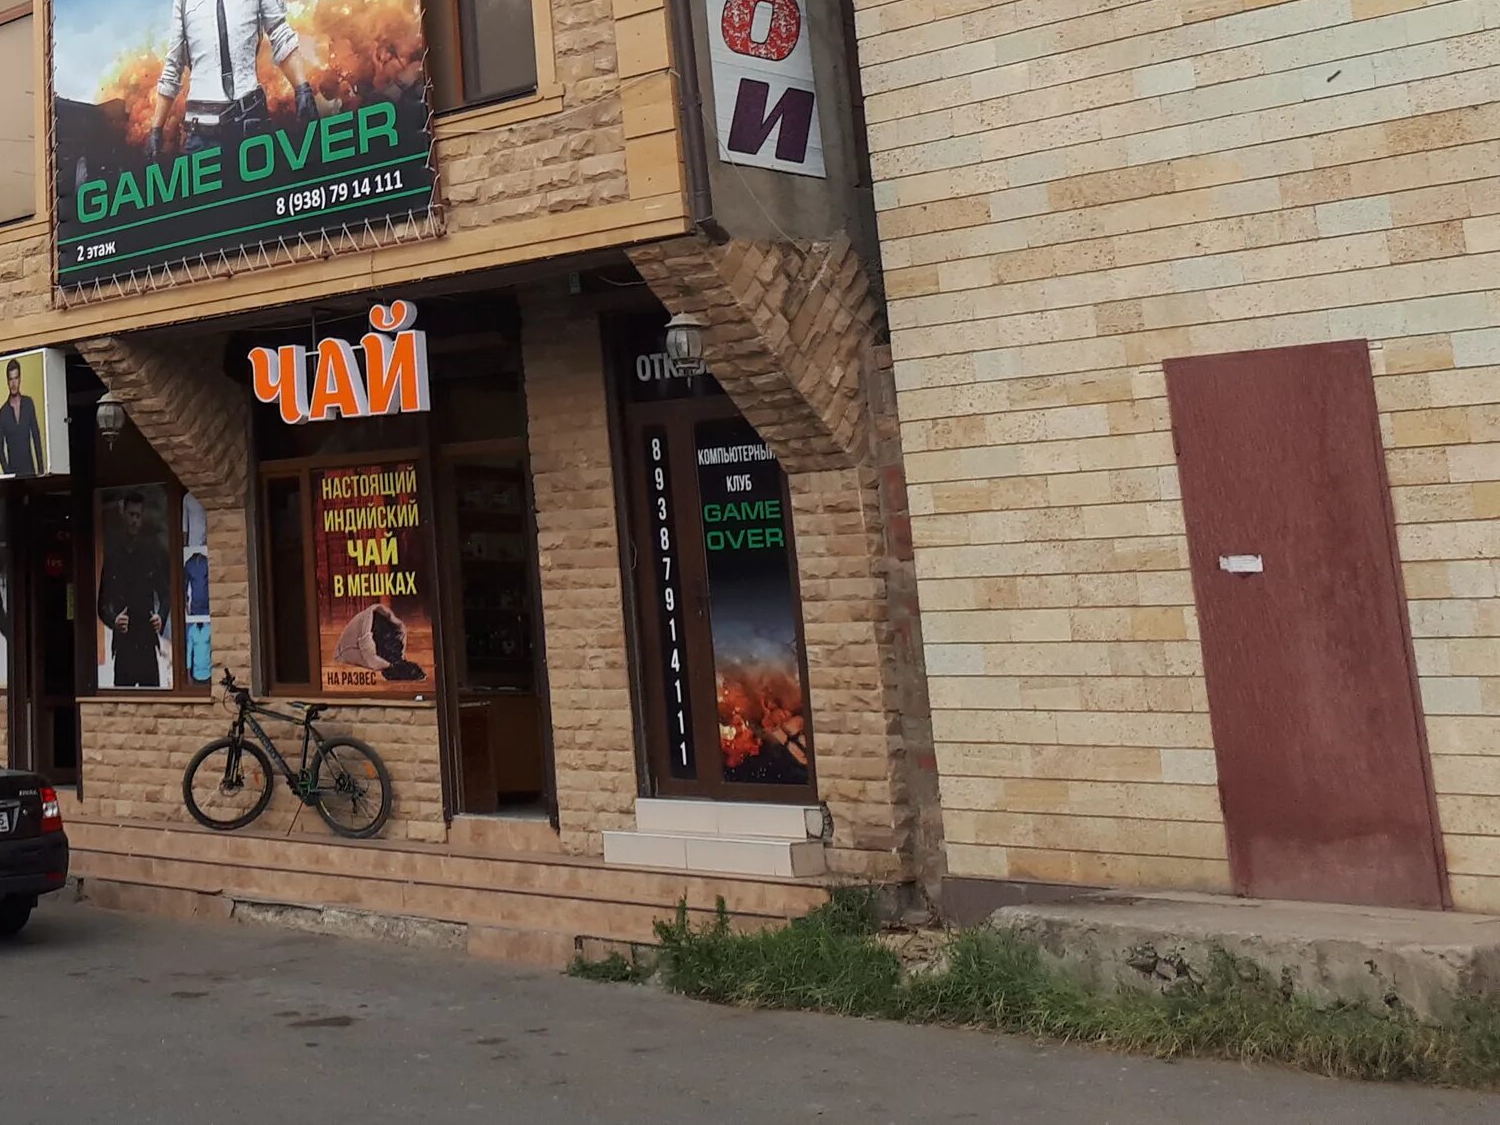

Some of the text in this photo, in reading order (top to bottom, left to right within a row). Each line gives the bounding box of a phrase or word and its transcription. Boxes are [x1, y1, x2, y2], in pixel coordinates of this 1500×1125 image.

[75, 101, 398, 225] GAME OVER
[276, 169, 403, 217] 8 (938) 79 14 111
[76, 238, 116, 262] 2 этаж
[247, 299, 430, 424] ЧАЙ
[322, 466, 418, 501] НАСТОЯЩИЙ
[726, 474, 752, 493] КЛУБ
[324, 498, 419, 534] ИНДИЙСКИЙ
[704, 500, 782, 523] GAME
[347, 531, 399, 567] ЧАЙ
[707, 528, 785, 551] OVER
[334, 571, 418, 598] В МЕШКАХ
[327, 670, 377, 686] НА РАЗВЕС
